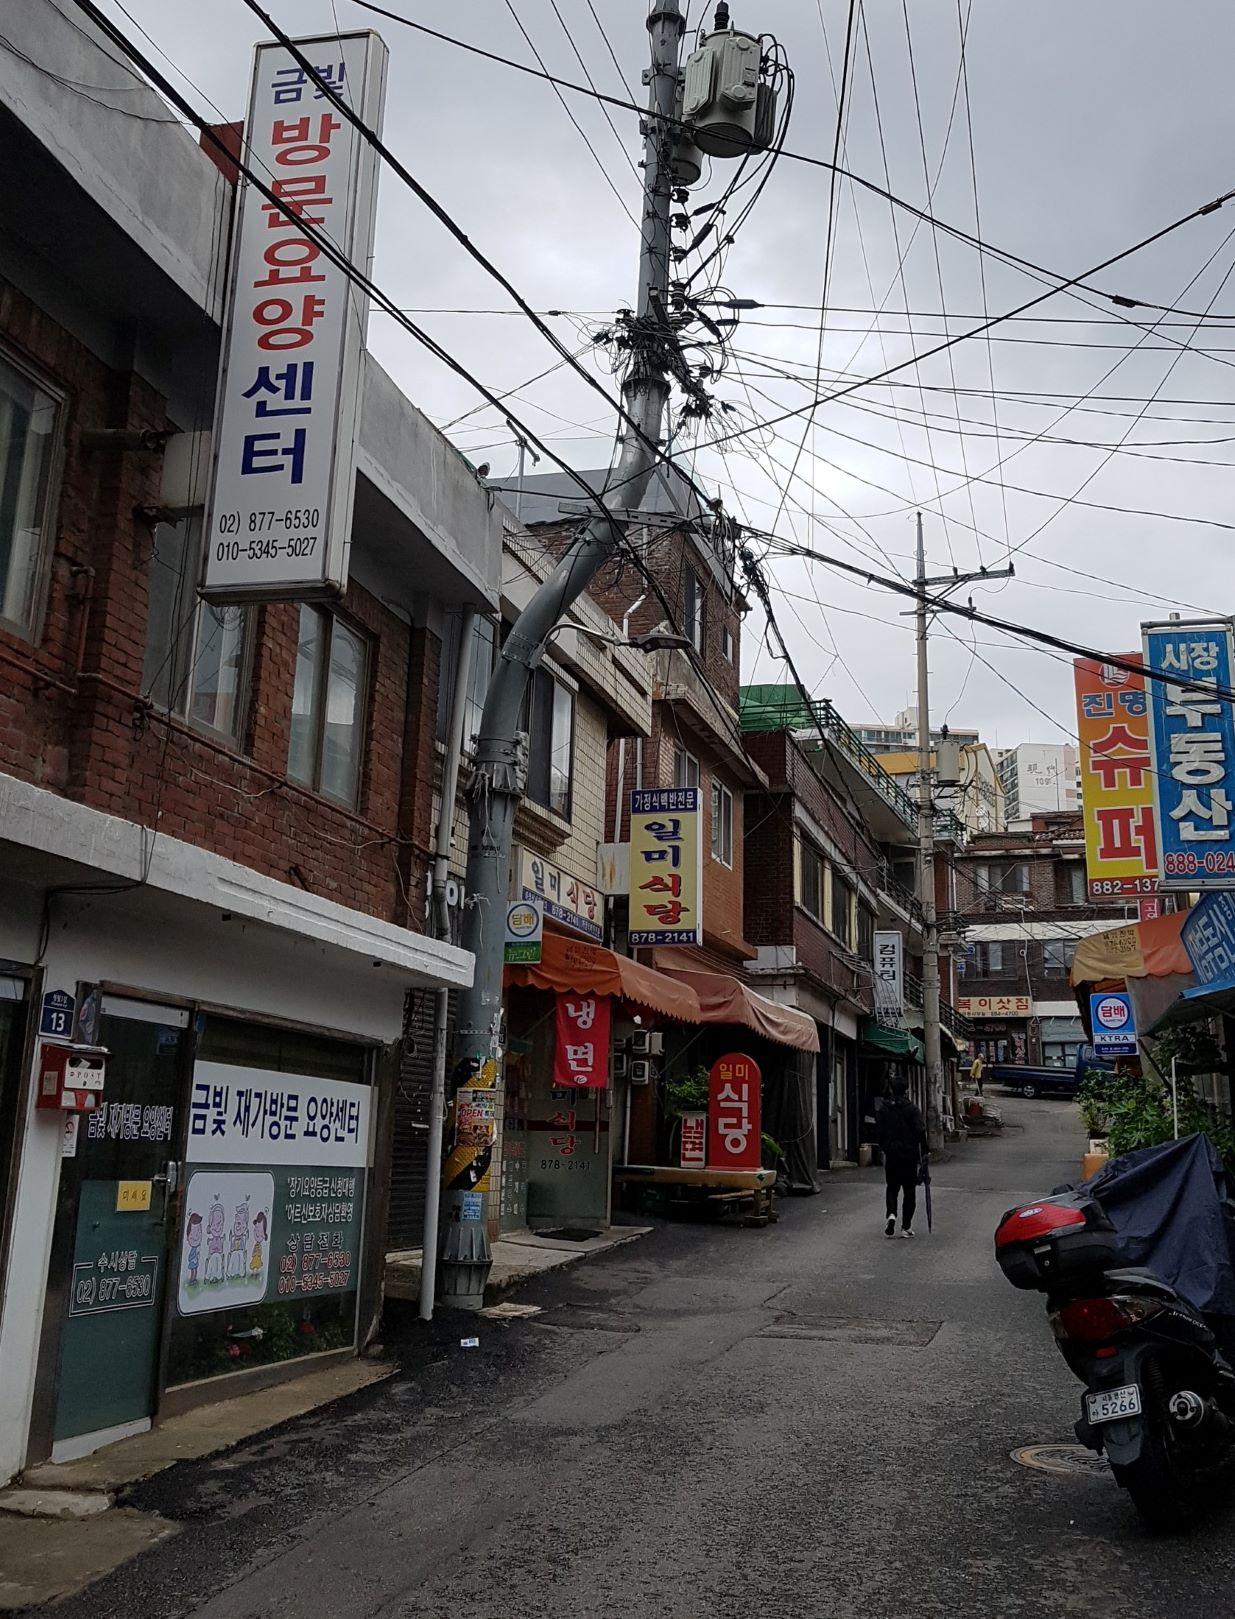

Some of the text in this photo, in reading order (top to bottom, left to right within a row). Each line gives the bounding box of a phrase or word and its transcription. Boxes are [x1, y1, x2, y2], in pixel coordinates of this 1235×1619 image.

[271, 62, 345, 104] 금빛
[219, 508, 320, 535] 02) 877-6530
[217, 536, 317, 561] 010-5345-5027
[1161, 642, 1219, 670] 시장
[1166, 677, 1233, 841] 부동산
[634, 791, 694, 811] 가정식백반전문
[1090, 723, 1158, 872] 슈퍼
[638, 818, 690, 925] 일미식당
[512, 912, 534, 928] 담배
[631, 932, 694, 944] 878-2141
[51, 1012, 66, 1032] 13
[1101, 1005, 1126, 1018] 담배
[564, 999, 595, 1072] 냉면
[1100, 1034, 1129, 1043] KTRA
[719, 1063, 749, 1080] 일미
[107, 1102, 142, 1140] 재가방문
[142, 1104, 174, 1141] 요양센터
[191, 1083, 361, 1145] 금빛 재가방문 요양센터
[717, 1082, 753, 1155] 식당
[540, 1159, 591, 1170] 878-2141
[97, 1250, 138, 1273] 수시상담
[99, 1273, 151, 1301] 877-6530
[1102, 1397, 1136, 1416] 5266
